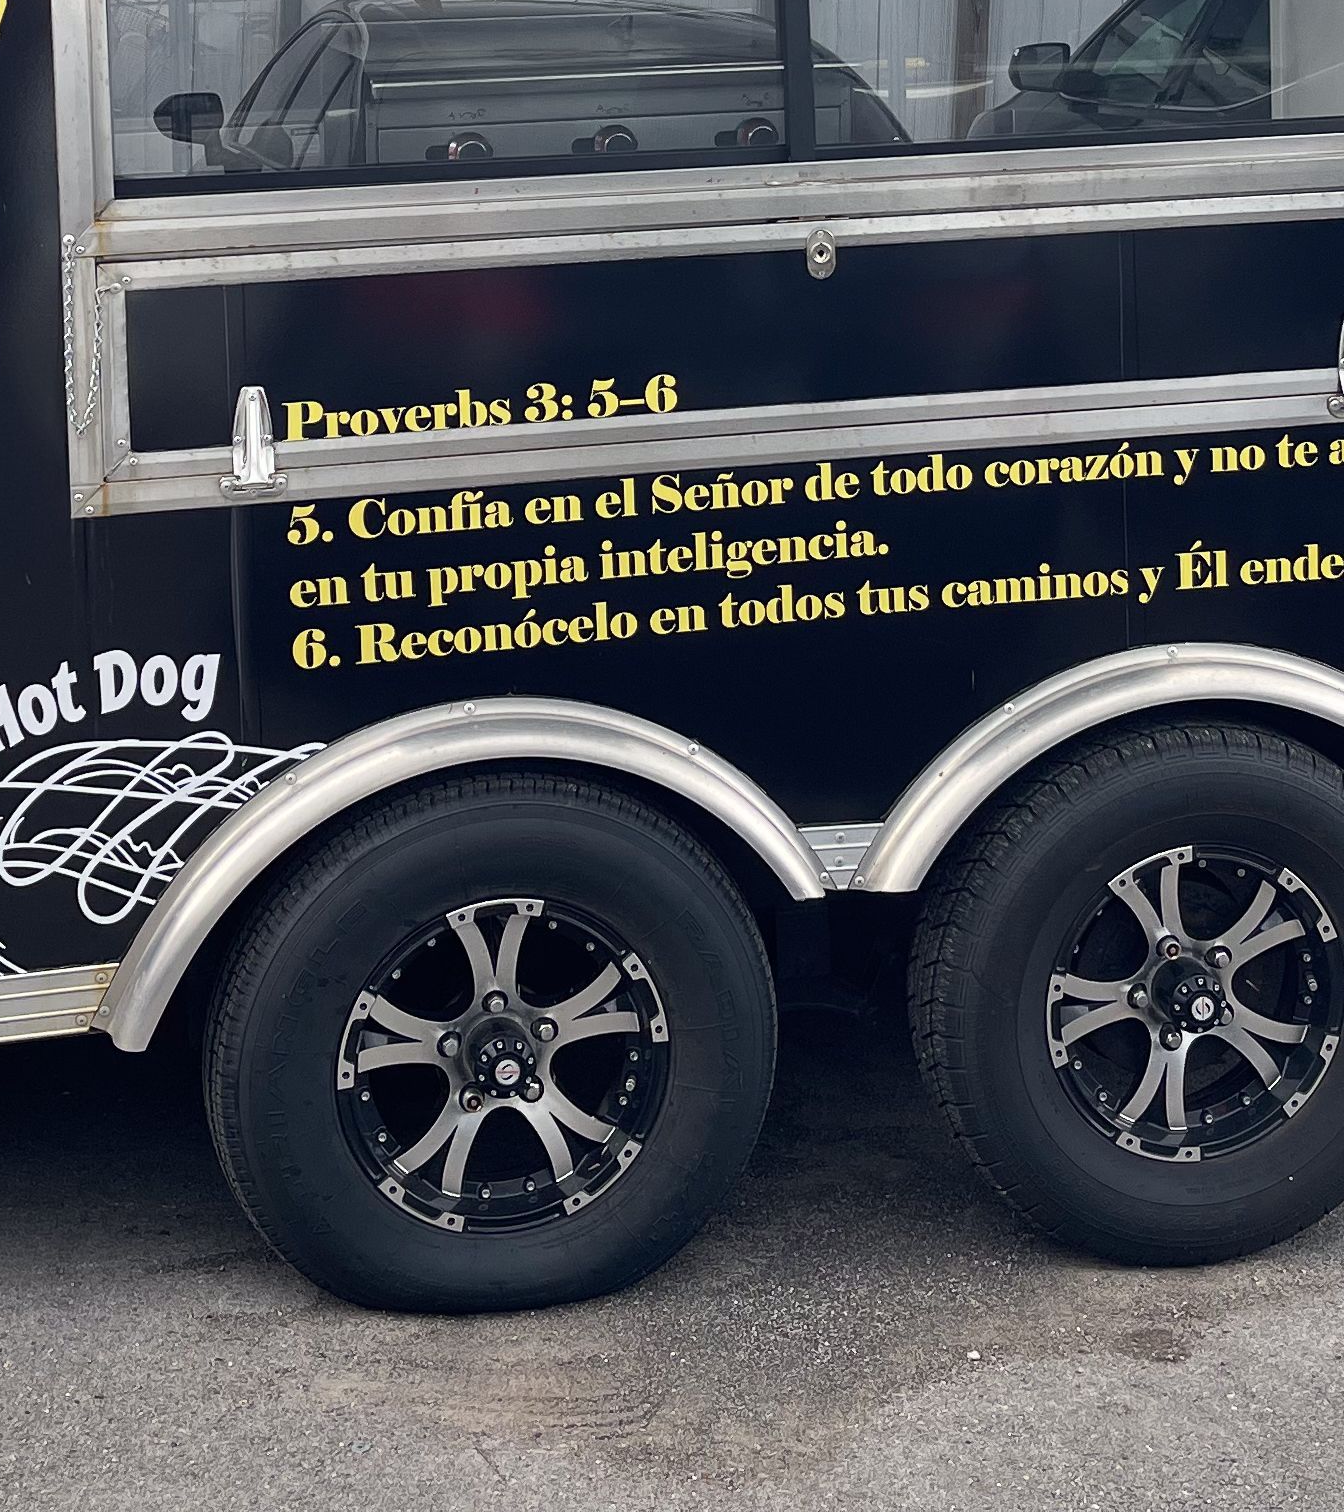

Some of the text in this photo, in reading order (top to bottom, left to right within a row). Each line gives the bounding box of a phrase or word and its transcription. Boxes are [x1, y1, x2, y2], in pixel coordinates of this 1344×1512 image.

[282, 389, 512, 442] Proverbs
[524, 382, 574, 422] 3:
[287, 505, 334, 545] 5.
[348, 490, 512, 539] Confía
[524, 489, 583, 525] en
[595, 477, 636, 519] el
[651, 473, 794, 512] Señor
[804, 462, 860, 502] de
[871, 453, 973, 496] todo
[984, 442, 1164, 488] corazón
[1173, 445, 1199, 486] y
[1211, 446, 1266, 472] no
[1277, 435, 1318, 468] te
[289, 520, 889, 608] en tu propia inteligencia.
[292, 629, 341, 669] 6.
[358, 601, 638, 665] Reconócelo
[649, 605, 706, 635] en
[720, 584, 846, 629] todos
[858, 583, 930, 616] tus
[941, 563, 1129, 608] caminos
[1138, 565, 1164, 604] y
[1175, 540, 1228, 590] Él
[93, 649, 221, 722] Dog
